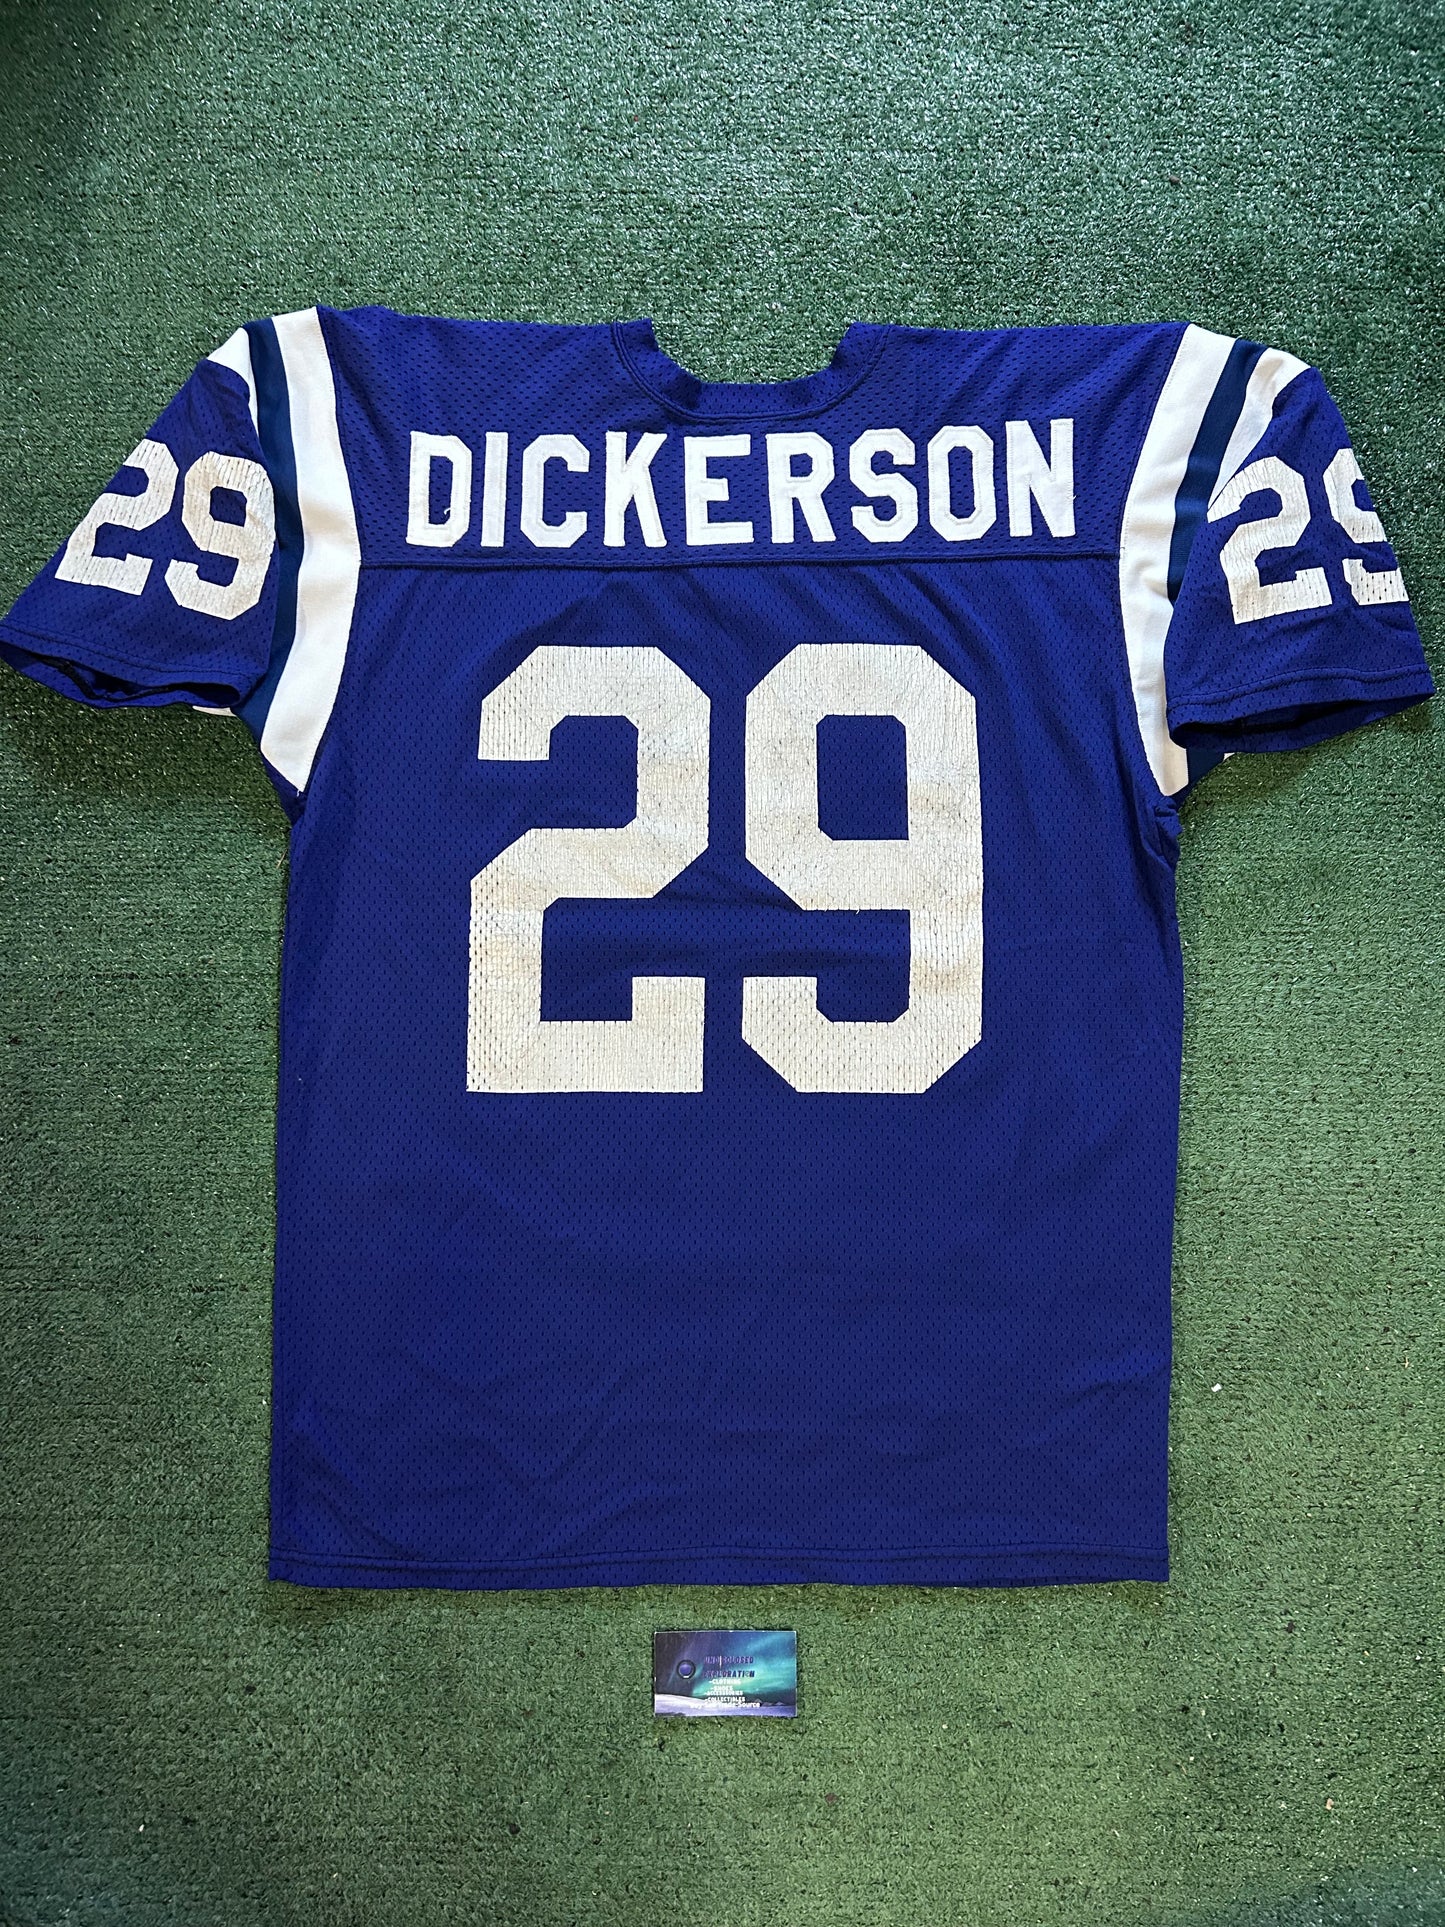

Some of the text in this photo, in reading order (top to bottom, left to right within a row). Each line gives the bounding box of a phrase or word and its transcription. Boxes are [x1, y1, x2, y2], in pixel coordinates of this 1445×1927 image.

[55, 439, 276, 620] 29
[406, 418, 1076, 548] DICKERSON
[1207, 448, 1409, 624] 29
[466, 643, 983, 1093] 29
